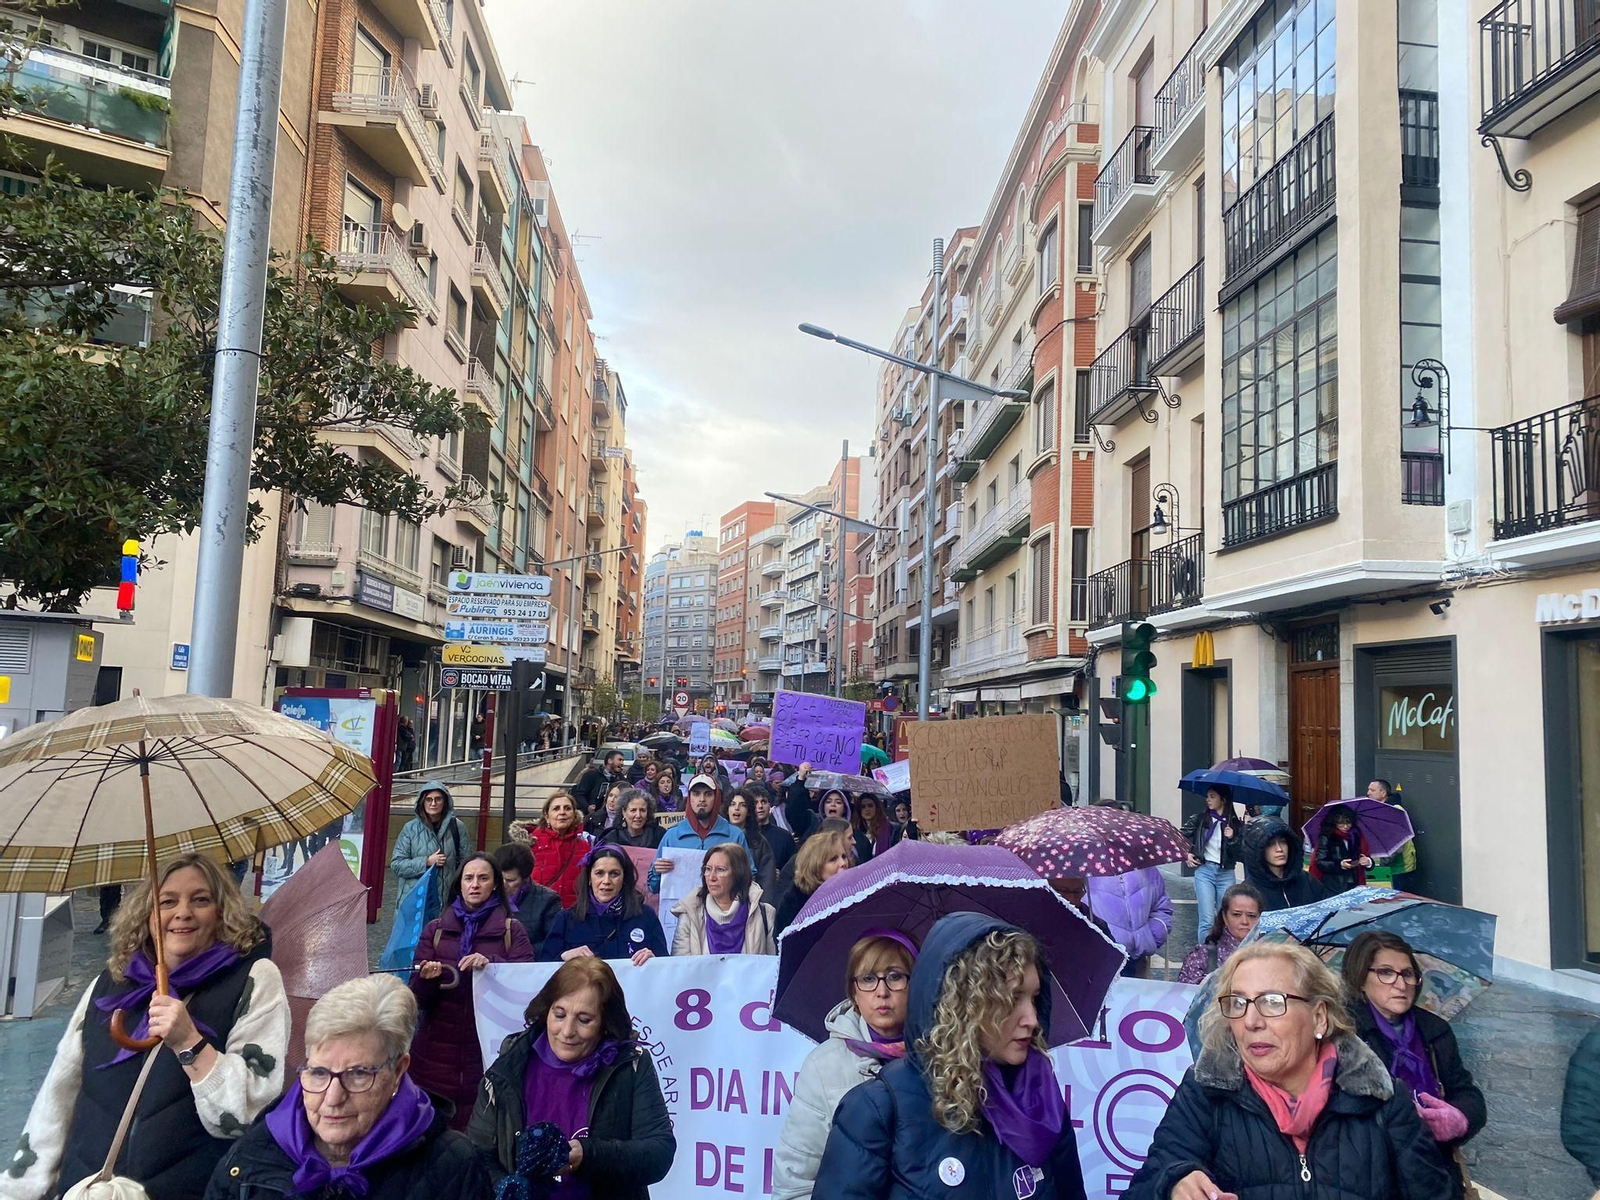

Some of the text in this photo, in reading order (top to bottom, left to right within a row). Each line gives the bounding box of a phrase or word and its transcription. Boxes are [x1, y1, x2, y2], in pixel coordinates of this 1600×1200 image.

[448, 596, 470, 604] ESPACIO
[471, 597, 500, 606] RESERVADO
[523, 600, 547, 608] EMPRESA
[469, 626, 514, 636] AURINGIS
[448, 654, 504, 664] VERCOCINAS
[461, 673, 488, 684] BOCAO
[281, 703, 306, 718] Colegio
[1388, 693, 1454, 738] McCaf
[834, 734, 856, 757] NO
[912, 725, 950, 751] CON
[954, 722, 982, 747] LOS
[793, 744, 807, 760] TU
[809, 748, 842, 766] CULPA
[916, 750, 941, 777] MI
[943, 747, 989, 774] CULO
[917, 774, 1031, 799] ESTRANGULO
[674, 988, 713, 1031] 8
[690, 1067, 748, 1115] DIA
[695, 1141, 745, 1193] DE
